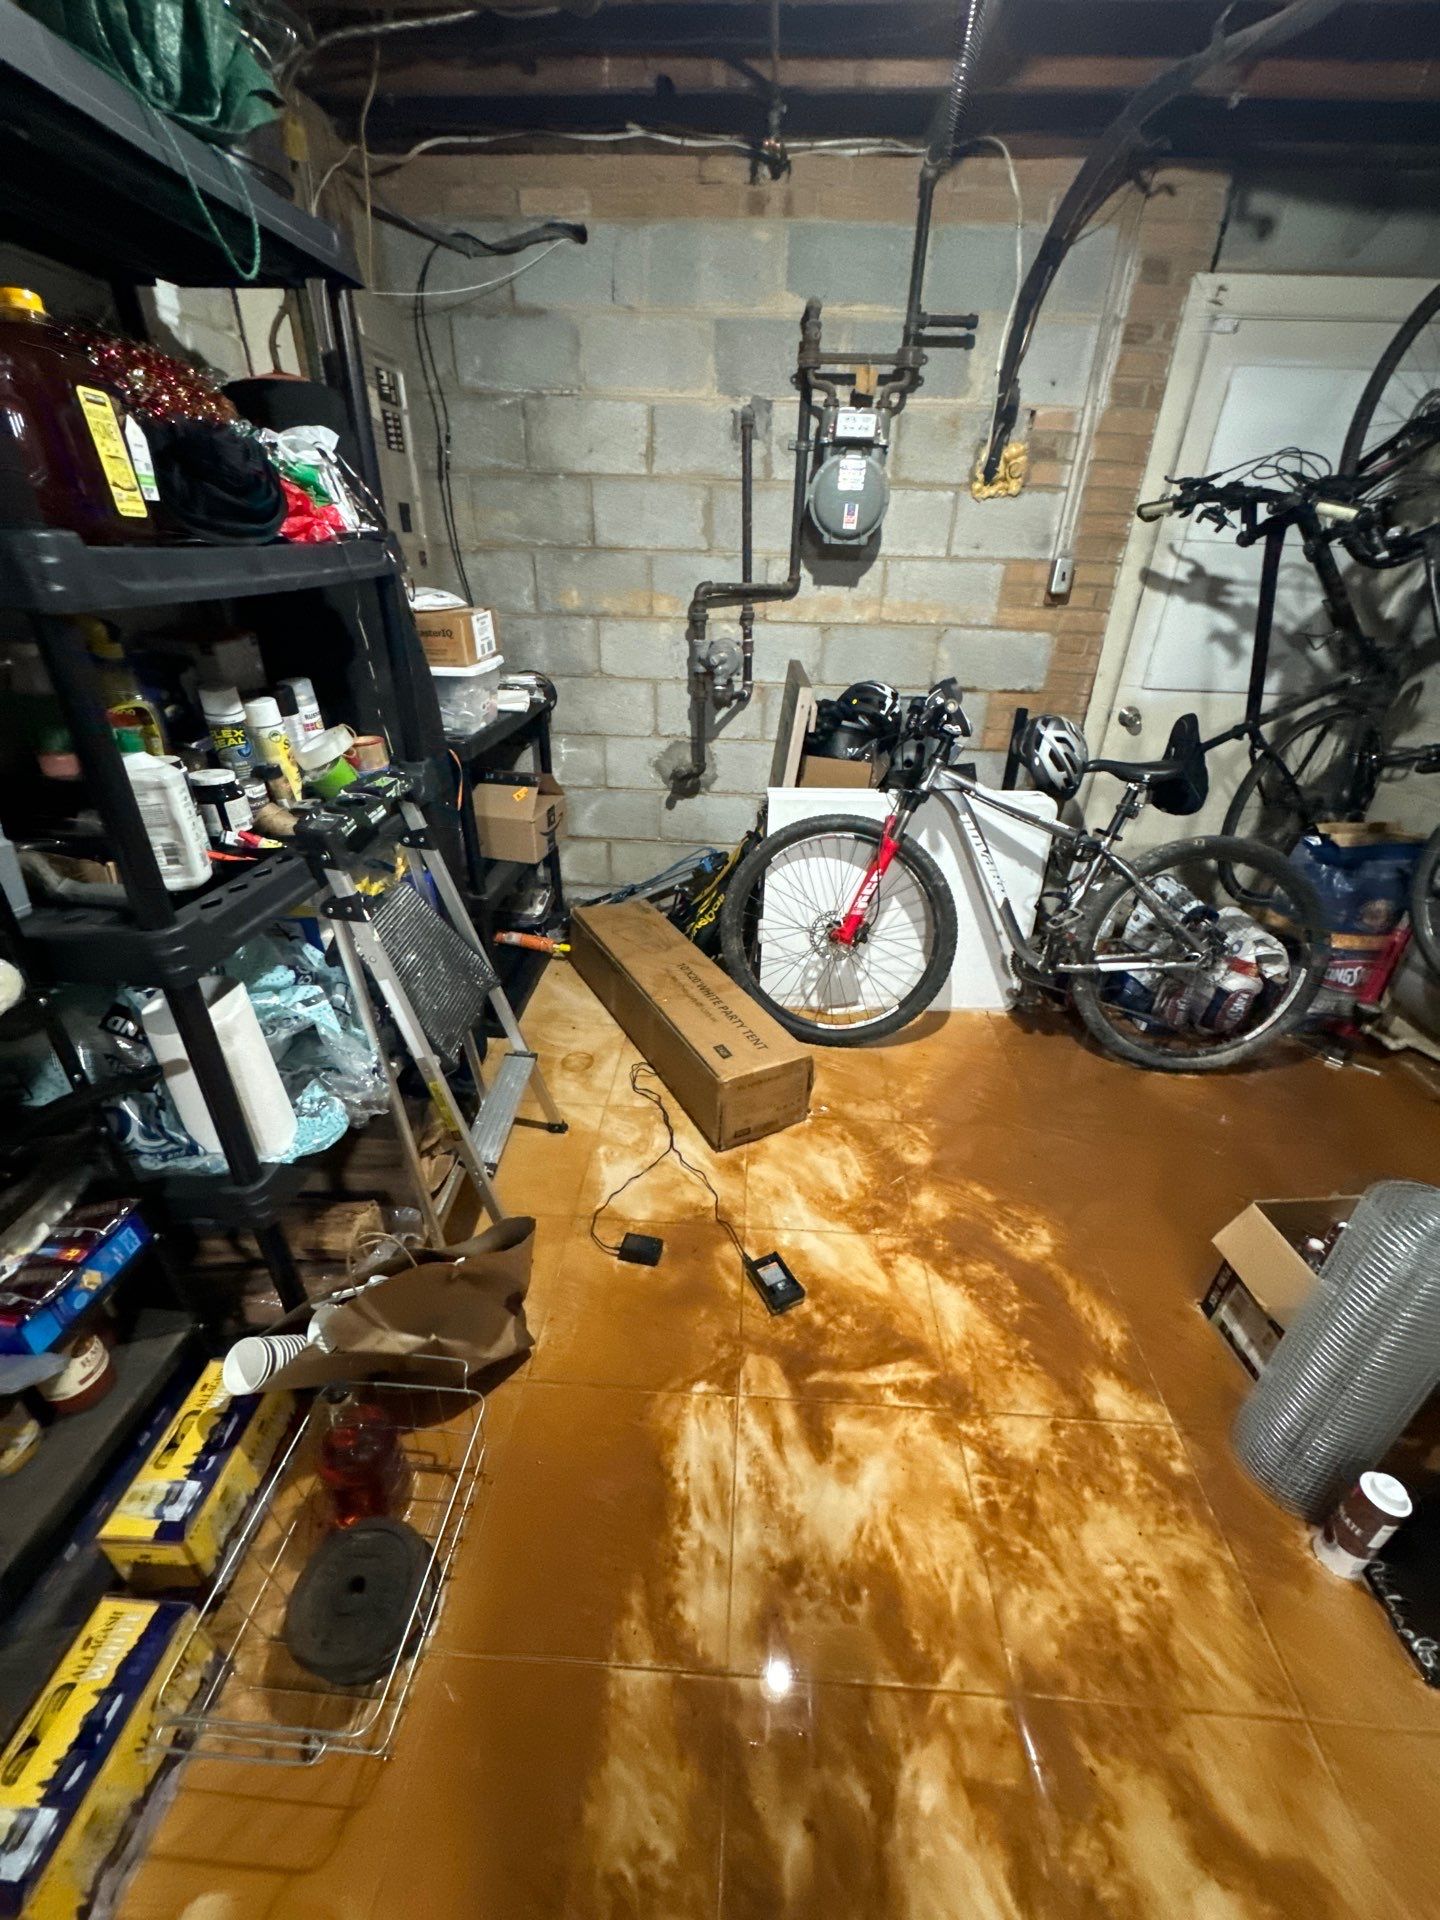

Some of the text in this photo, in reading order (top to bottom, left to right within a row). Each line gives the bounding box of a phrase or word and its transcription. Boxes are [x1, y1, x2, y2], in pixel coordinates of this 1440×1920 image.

[720, 1005, 747, 1029] PARTY
[743, 1029, 768, 1050] TENT
[72, 1611, 125, 1676] ALLAGASH
[80, 1612, 143, 1681] WHITE
